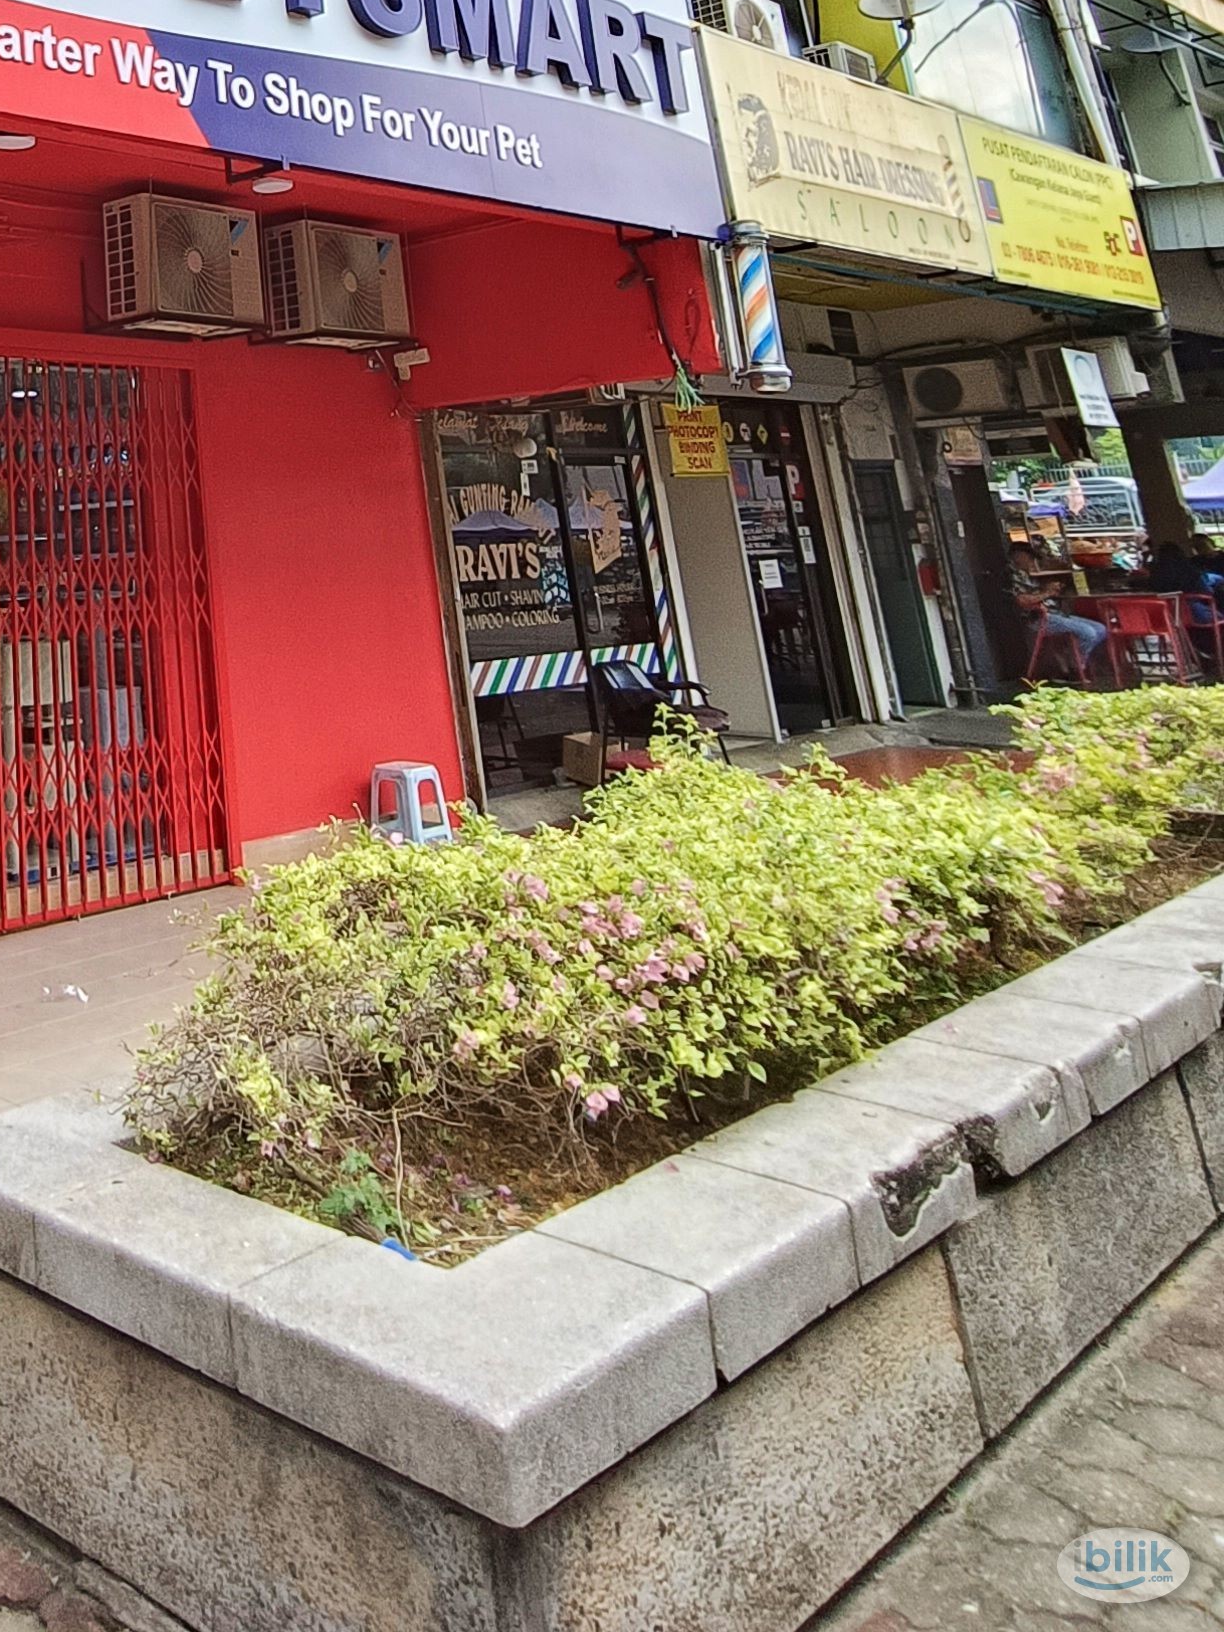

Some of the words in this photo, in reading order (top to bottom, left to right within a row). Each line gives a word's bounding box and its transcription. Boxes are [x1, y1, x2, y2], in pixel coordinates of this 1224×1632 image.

[110, 37, 200, 107] Way
[206, 59, 257, 110] To
[262, 71, 355, 137] Shop
[360, 93, 416, 141] For
[418, 106, 491, 156] Your
[493, 123, 544, 169] Pet
[838, 144, 881, 190] HAIR
[679, 440, 716, 454] BINDING
[687, 456, 713, 470] SCAN
[455, 542, 541, 583] RAVI'S
[481, 591, 502, 608] CUT
[510, 589, 546, 607] SHAVIN
[466, 612, 504, 631] AMPOO
[511, 608, 560, 628] COLORING
